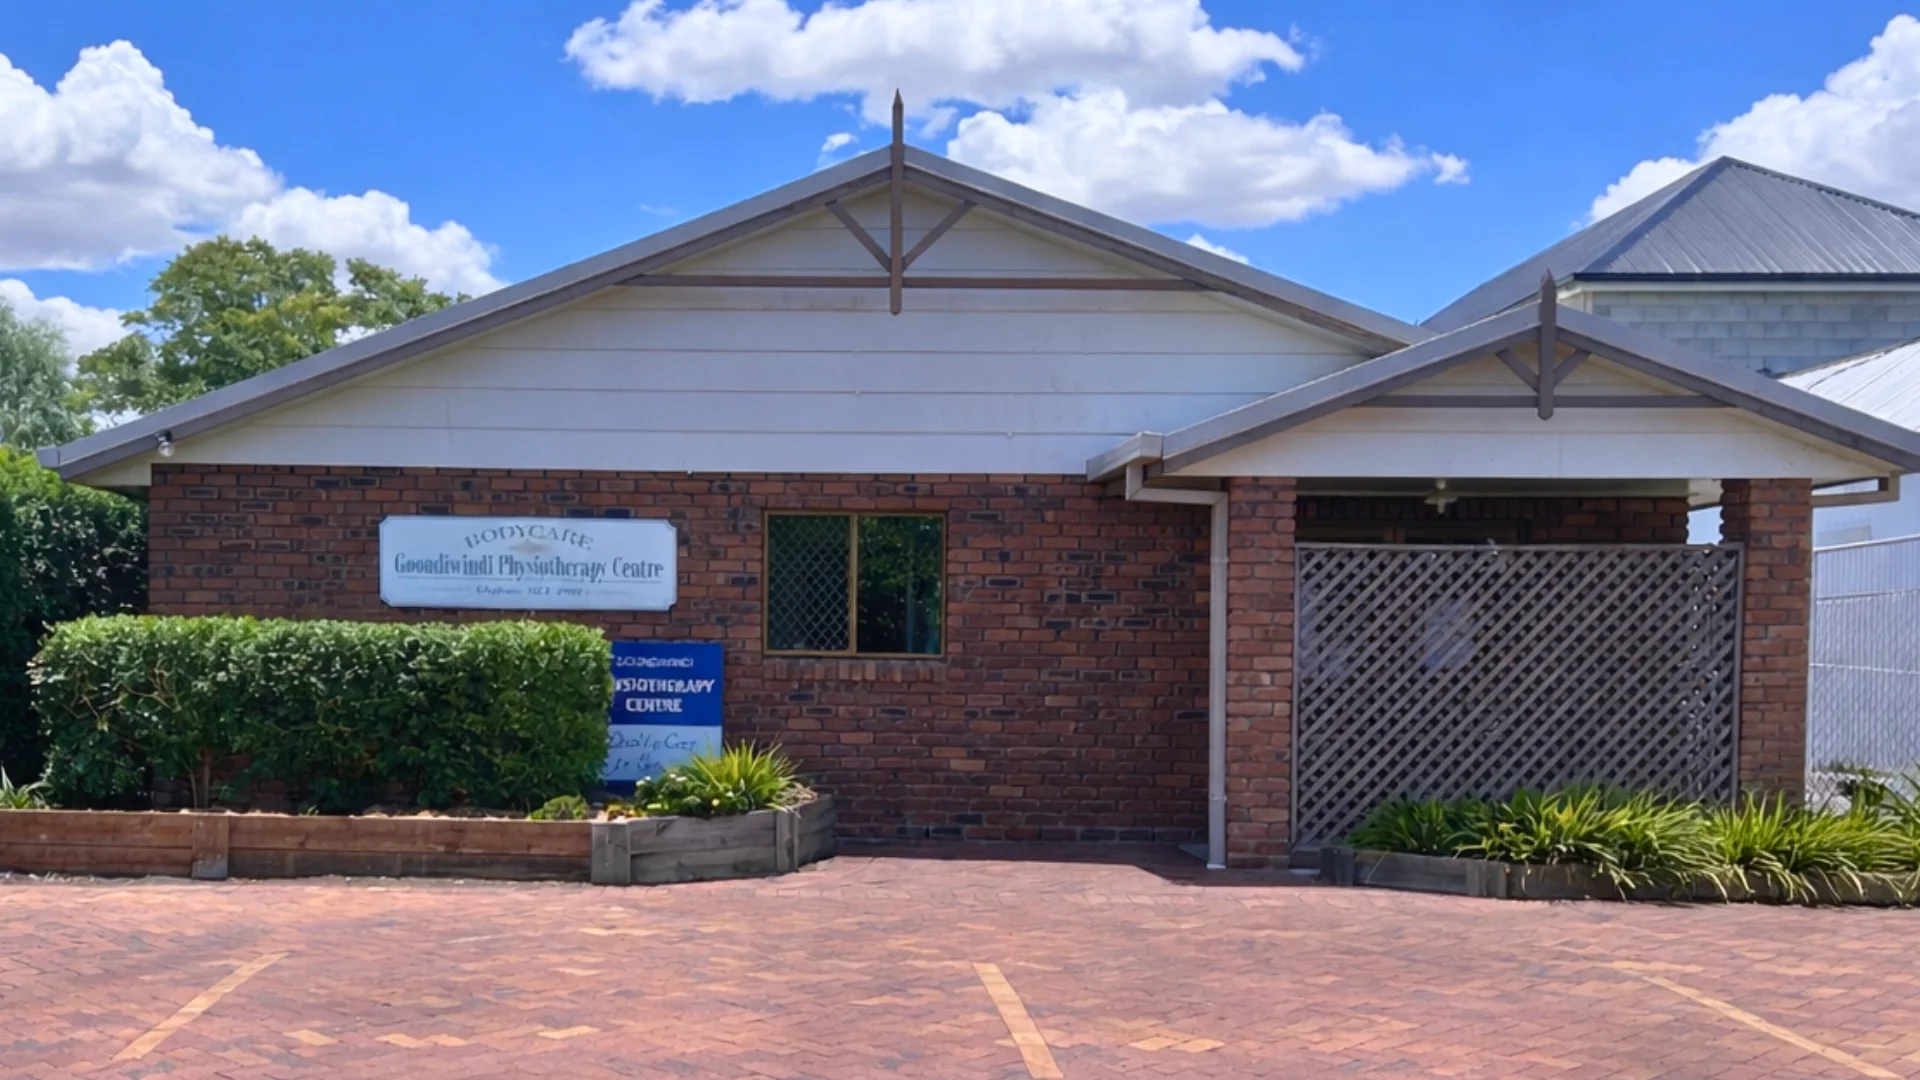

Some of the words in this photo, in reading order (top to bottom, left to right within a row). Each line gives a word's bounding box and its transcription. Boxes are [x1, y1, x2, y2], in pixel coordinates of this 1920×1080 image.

[464, 524, 594, 550] BODYCARE
[395, 553, 493, 576] Goondiwindi
[498, 554, 606, 583] Physiotherapy
[612, 556, 664, 578] Centre
[625, 698, 683, 712] CENTRE
